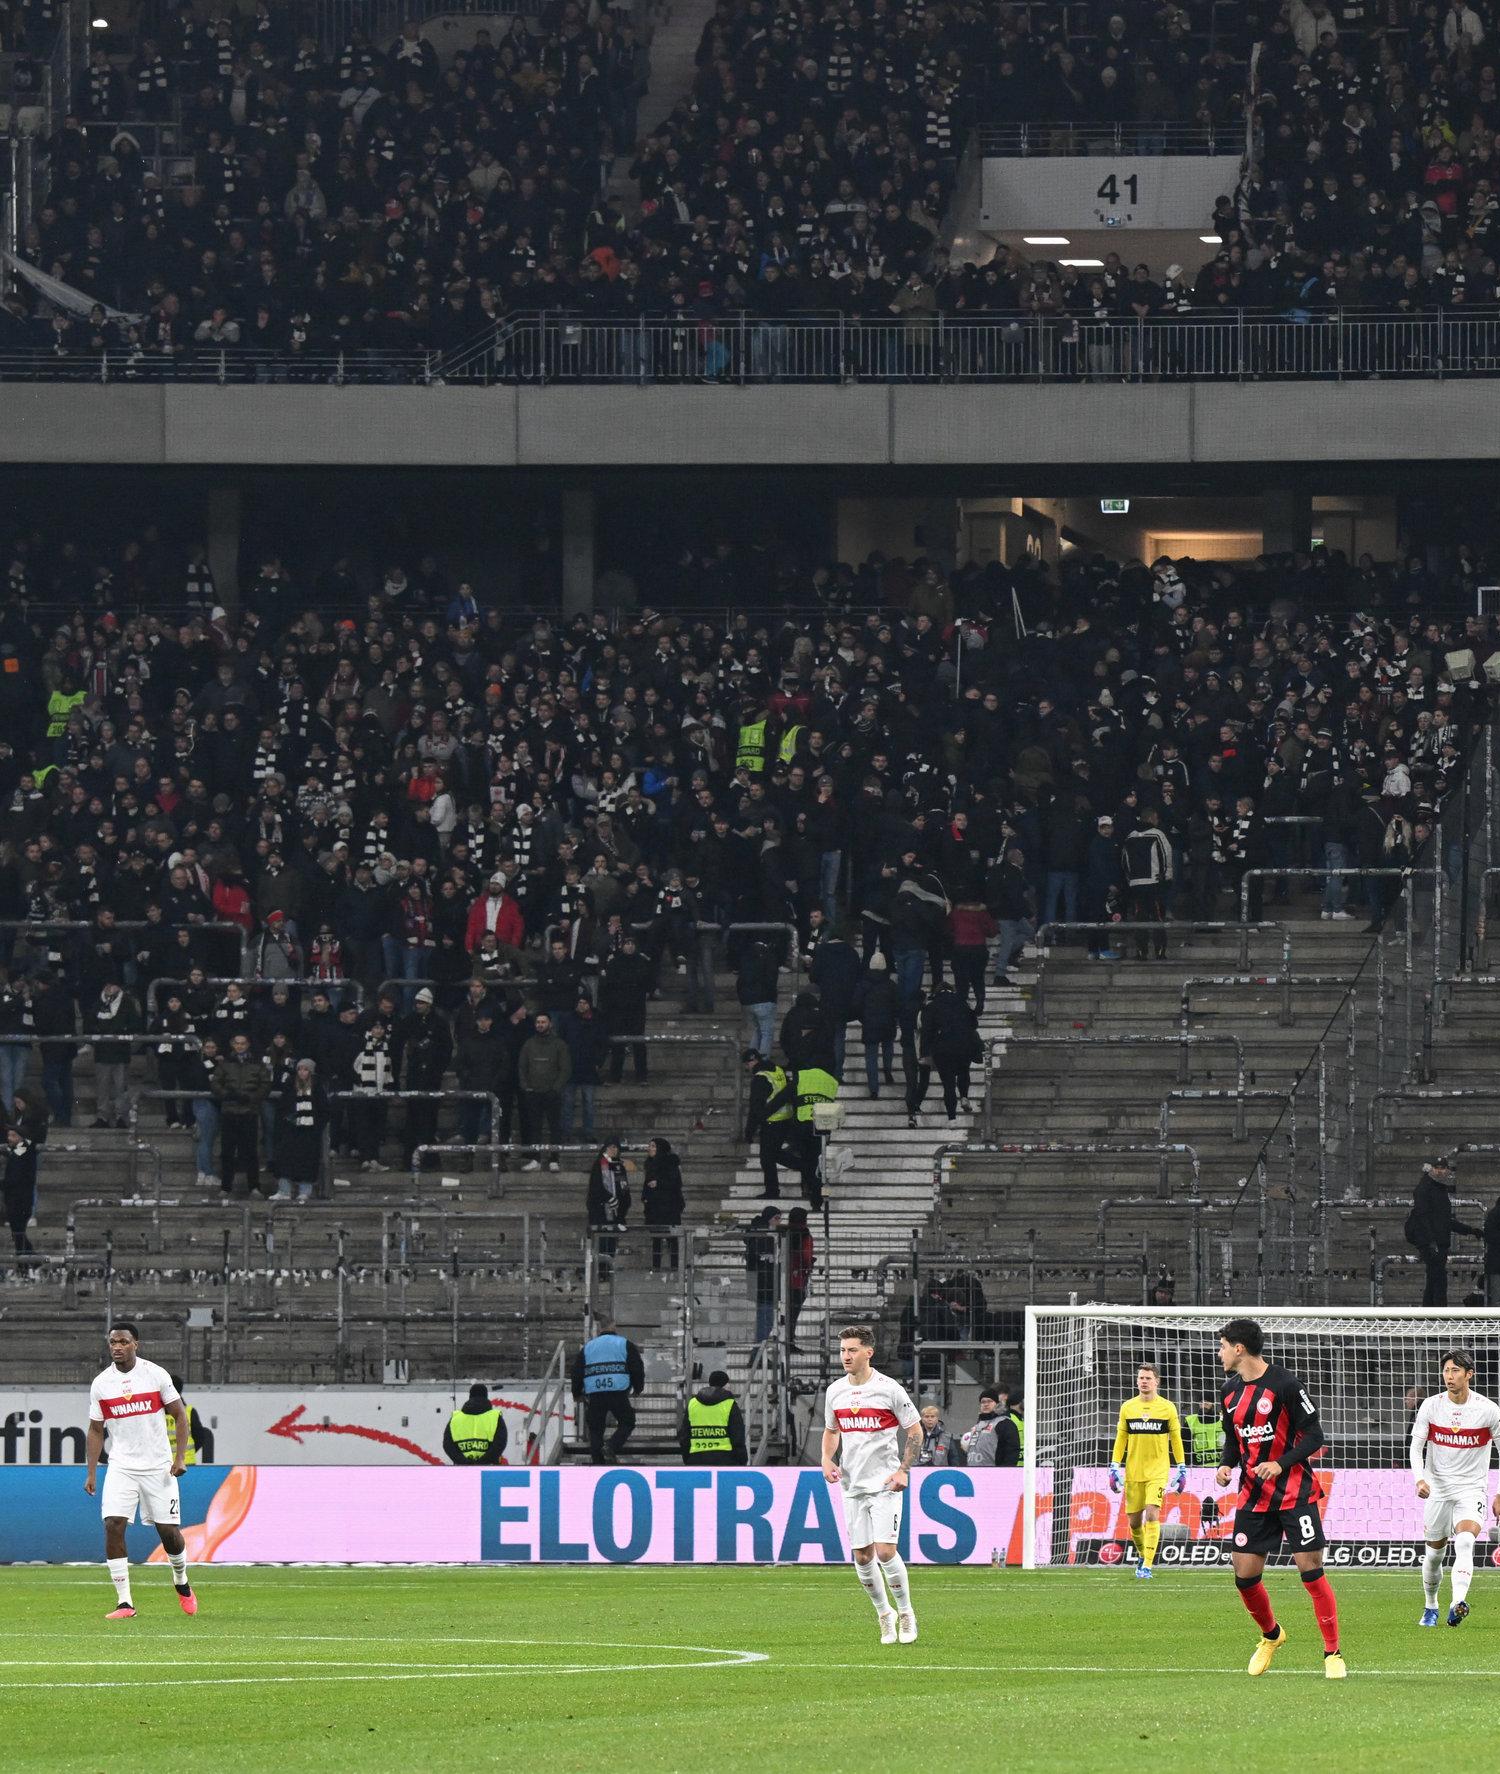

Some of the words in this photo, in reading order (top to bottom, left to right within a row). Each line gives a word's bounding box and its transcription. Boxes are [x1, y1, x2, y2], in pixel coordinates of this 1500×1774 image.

[1097, 173, 1138, 205] 41
[595, 1377, 614, 1389] 045
[110, 1400, 152, 1417] WINAMAX
[691, 1427, 727, 1437] STEWARD
[1129, 1422, 1163, 1432] WINAMAX
[1434, 1432, 1480, 1446] WINAMAX
[480, 1469, 977, 1563] ELOTRAS
[893, 1514, 899, 1531] 6
[1299, 1515, 1315, 1538] 8
[1161, 1545, 1220, 1562] OLED
[1322, 1546, 1350, 1564] LG
[1358, 1546, 1416, 1564] OLED
